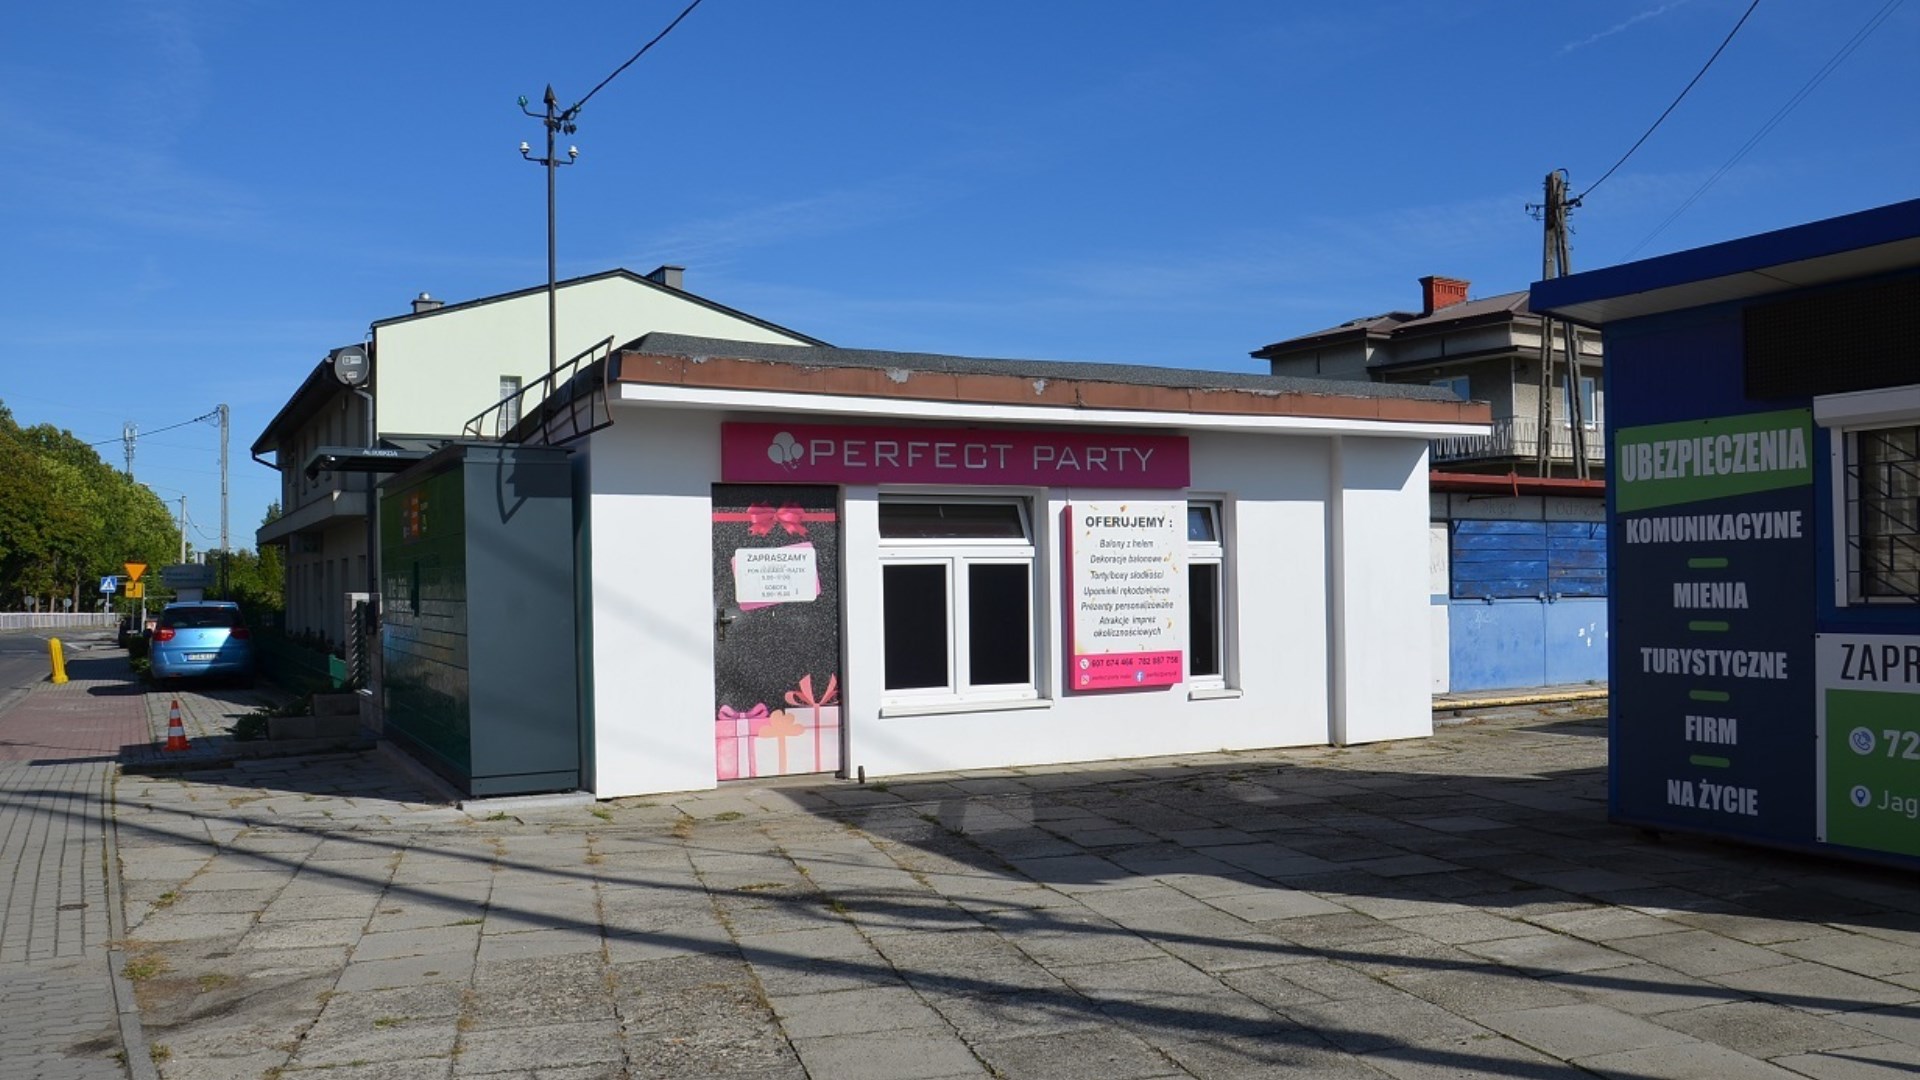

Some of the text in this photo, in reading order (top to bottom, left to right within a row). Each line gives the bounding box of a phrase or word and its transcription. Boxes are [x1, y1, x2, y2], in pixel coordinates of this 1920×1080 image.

[810, 439, 1155, 472] PERFECT PARTY
[1621, 428, 1807, 482] UBEZPIECZENIA
[1086, 516, 1165, 527] OFERUJEMY
[1626, 510, 1802, 543] KOMUNIKACYJNE
[747, 554, 807, 562] ZAPRASZAMY
[1100, 540, 1125, 550] Balony
[1132, 539, 1153, 548] helem
[1091, 555, 1162, 564] Dekoracje balonowe
[1084, 586, 1170, 596] Upominki rękodzielnicze
[1673, 582, 1748, 609] MIENIA
[1099, 616, 1156, 625] Atrakcje imprez
[1640, 647, 1787, 680] TURYSTYCZNE
[1685, 715, 1737, 746] FIRM
[1667, 778, 1758, 816] NA ŻYCIE
